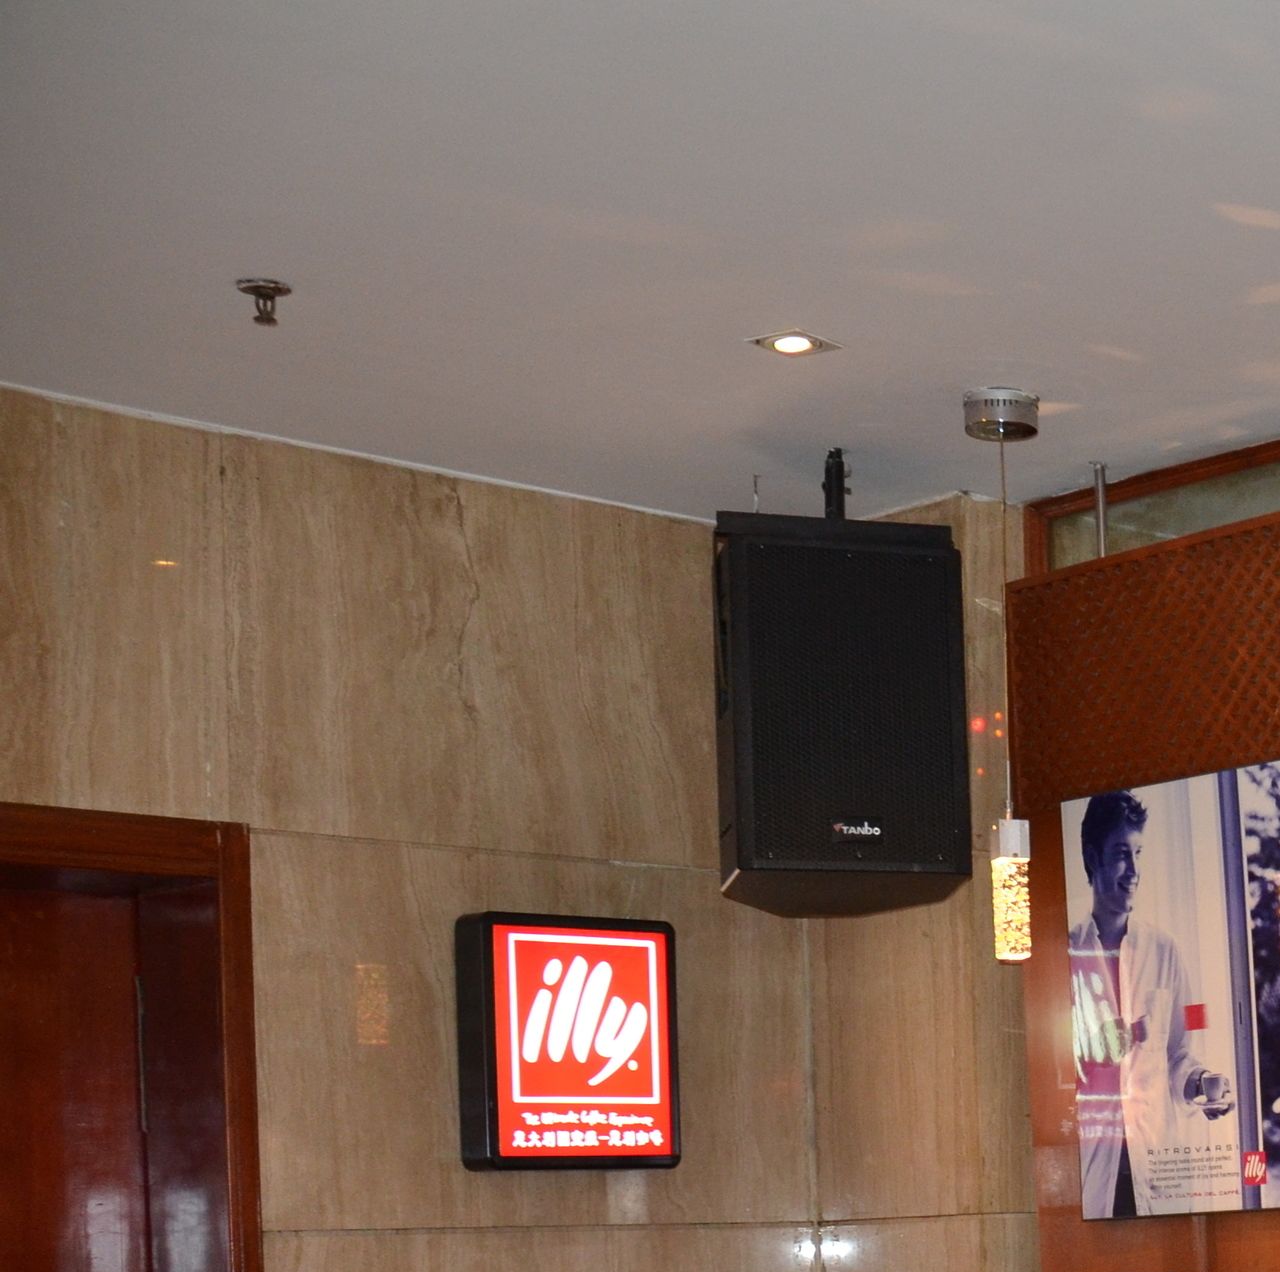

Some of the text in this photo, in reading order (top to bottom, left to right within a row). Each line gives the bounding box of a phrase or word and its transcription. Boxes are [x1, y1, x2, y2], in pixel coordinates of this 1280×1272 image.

[521, 954, 648, 1087] illy
[1147, 1144, 1240, 1156] RITROVARSI
[1244, 1154, 1266, 1183] illy
